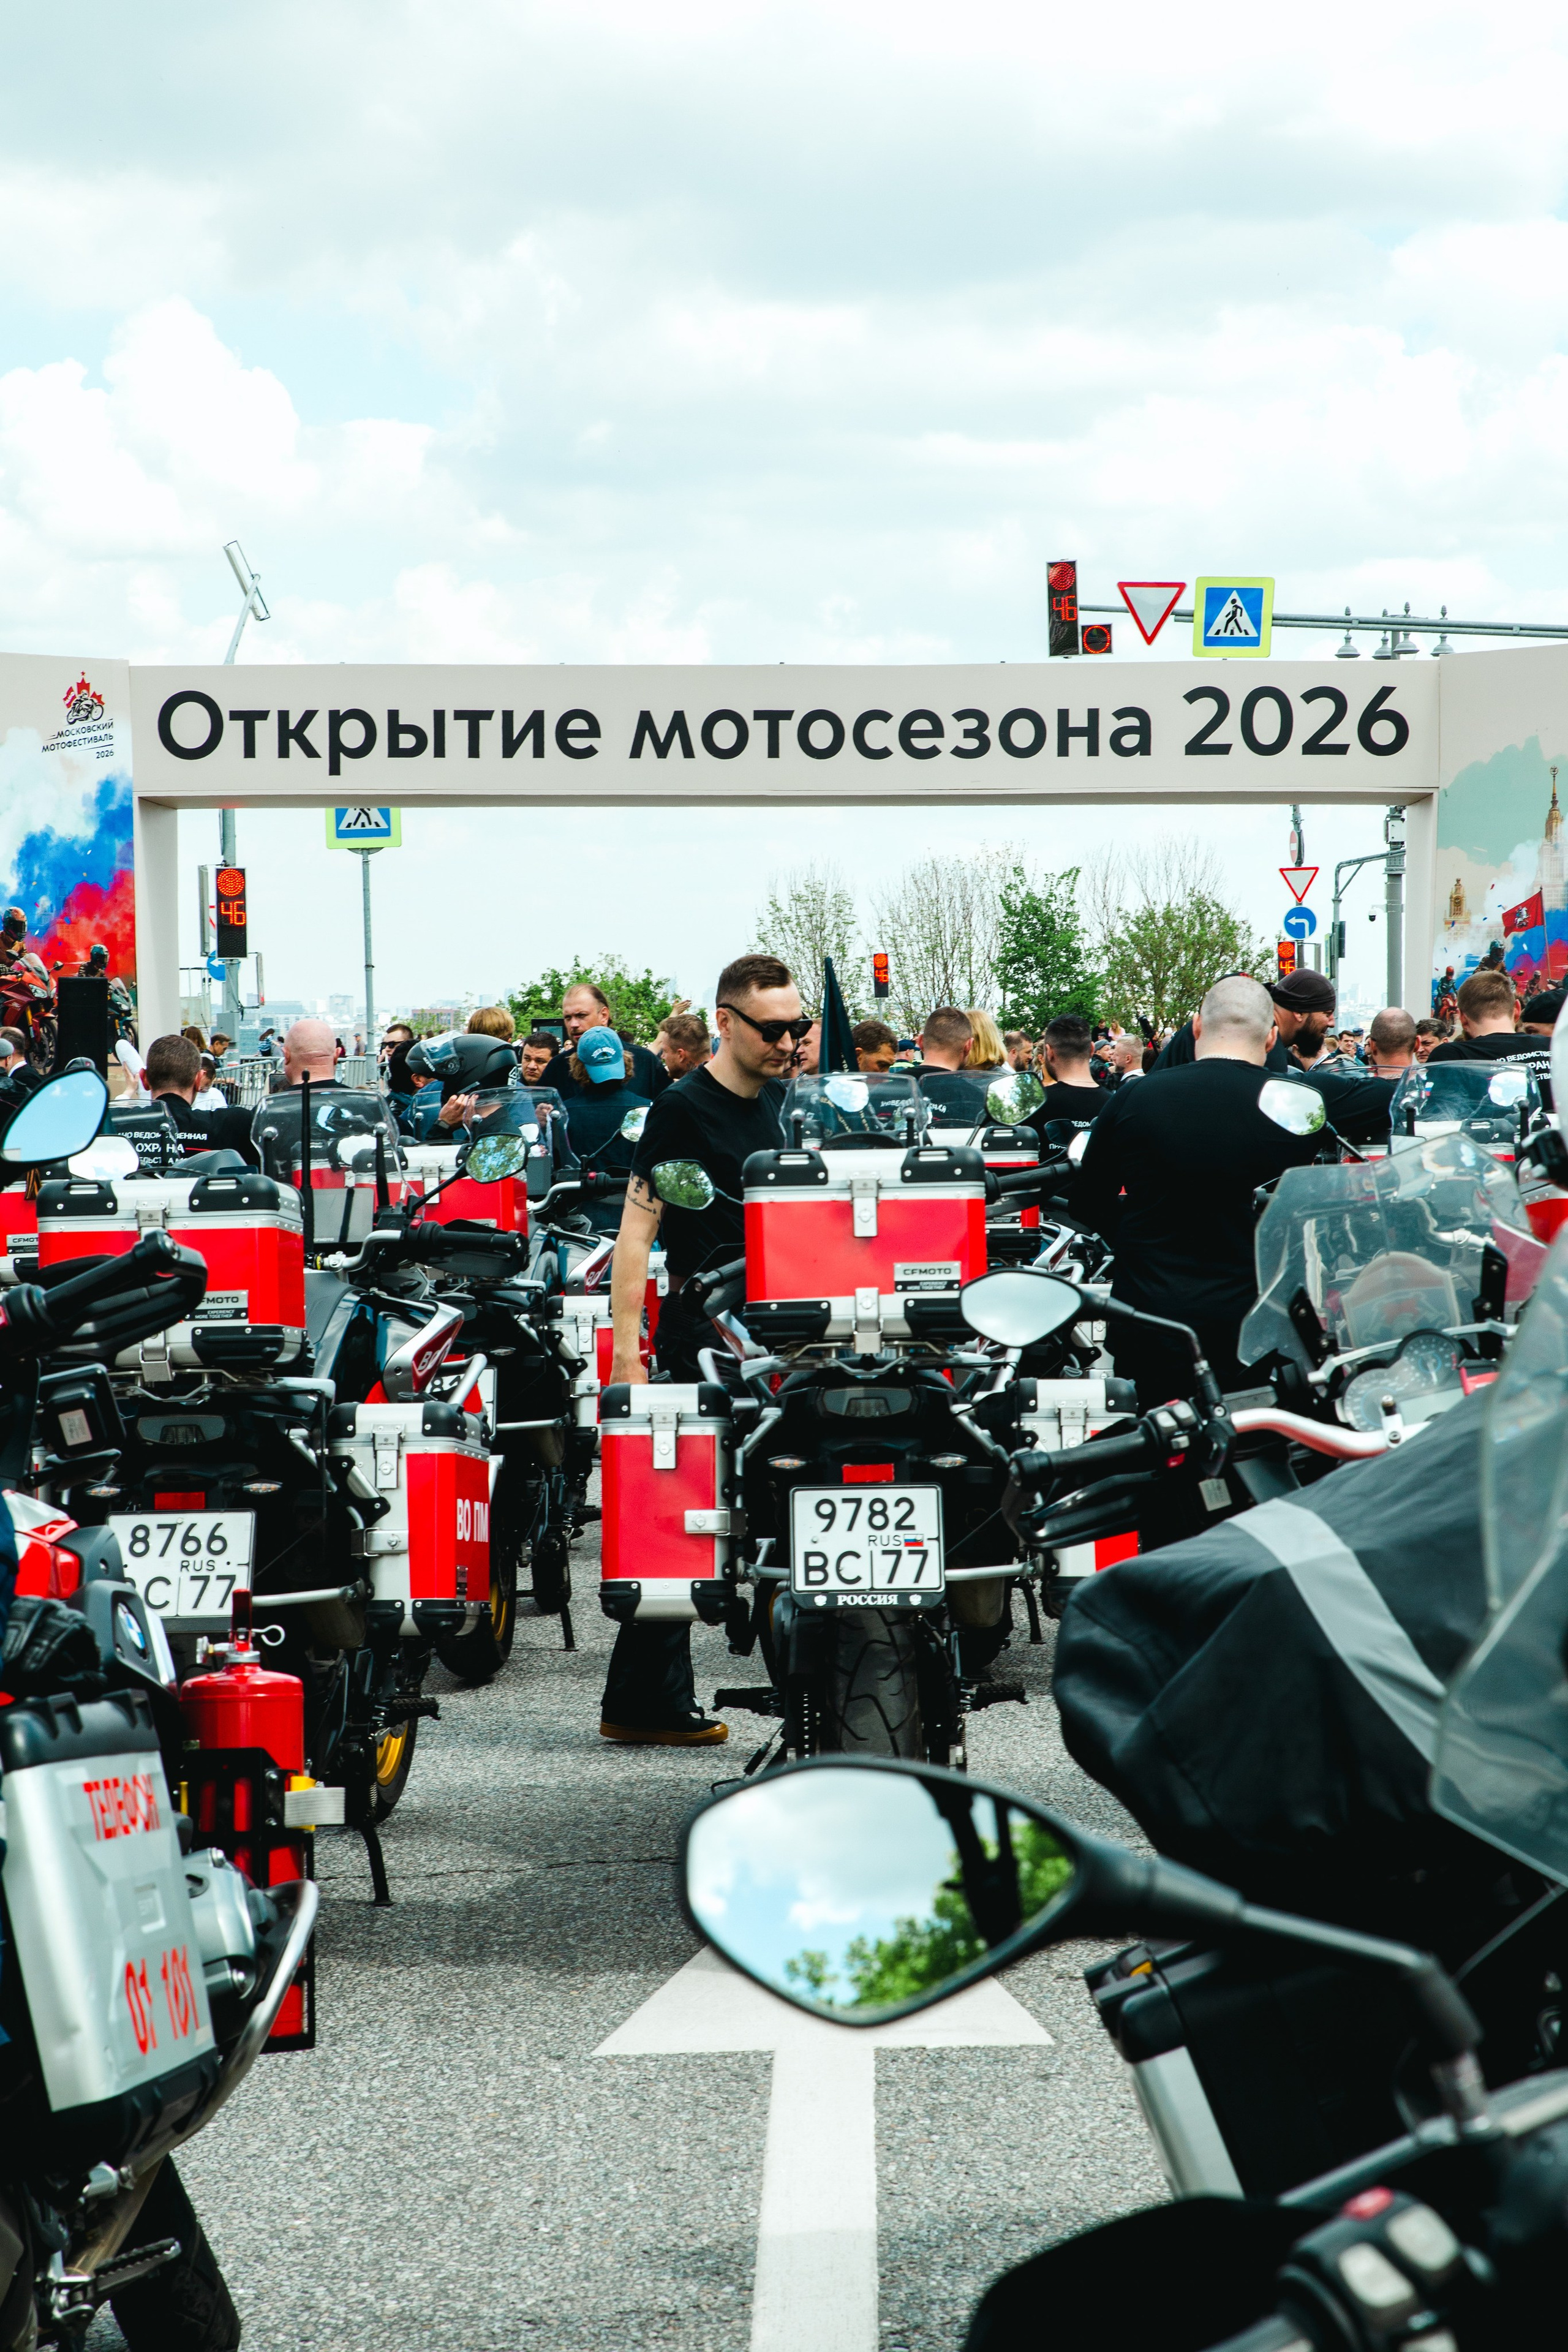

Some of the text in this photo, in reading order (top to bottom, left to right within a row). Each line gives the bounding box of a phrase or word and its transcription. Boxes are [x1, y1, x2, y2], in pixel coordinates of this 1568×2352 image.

[1052, 595, 1077, 621] 46
[56, 718, 113, 739] МОСКОВСКИЙ
[158, 686, 1409, 775] Открытие мотосезона 2026
[42, 733, 113, 753] МОТОФЕСТИВАЛЬ
[96, 750, 114, 759] 2026
[221, 901, 246, 925] 46
[875, 969, 889, 982] 46
[457, 1499, 488, 1542] ВО ПМ
[815, 1497, 915, 1532] 9782
[129, 1523, 227, 1557] 8766
[868, 1535, 902, 1546] RUS
[181, 1559, 215, 1572] RUS
[804, 1550, 928, 1586] ВС 77
[190, 1575, 236, 1608] 77
[837, 1594, 899, 1605] РОССИЯ
[83, 1774, 160, 1841] ТЕЛЕФОН
[124, 1944, 199, 2056] 01 101
